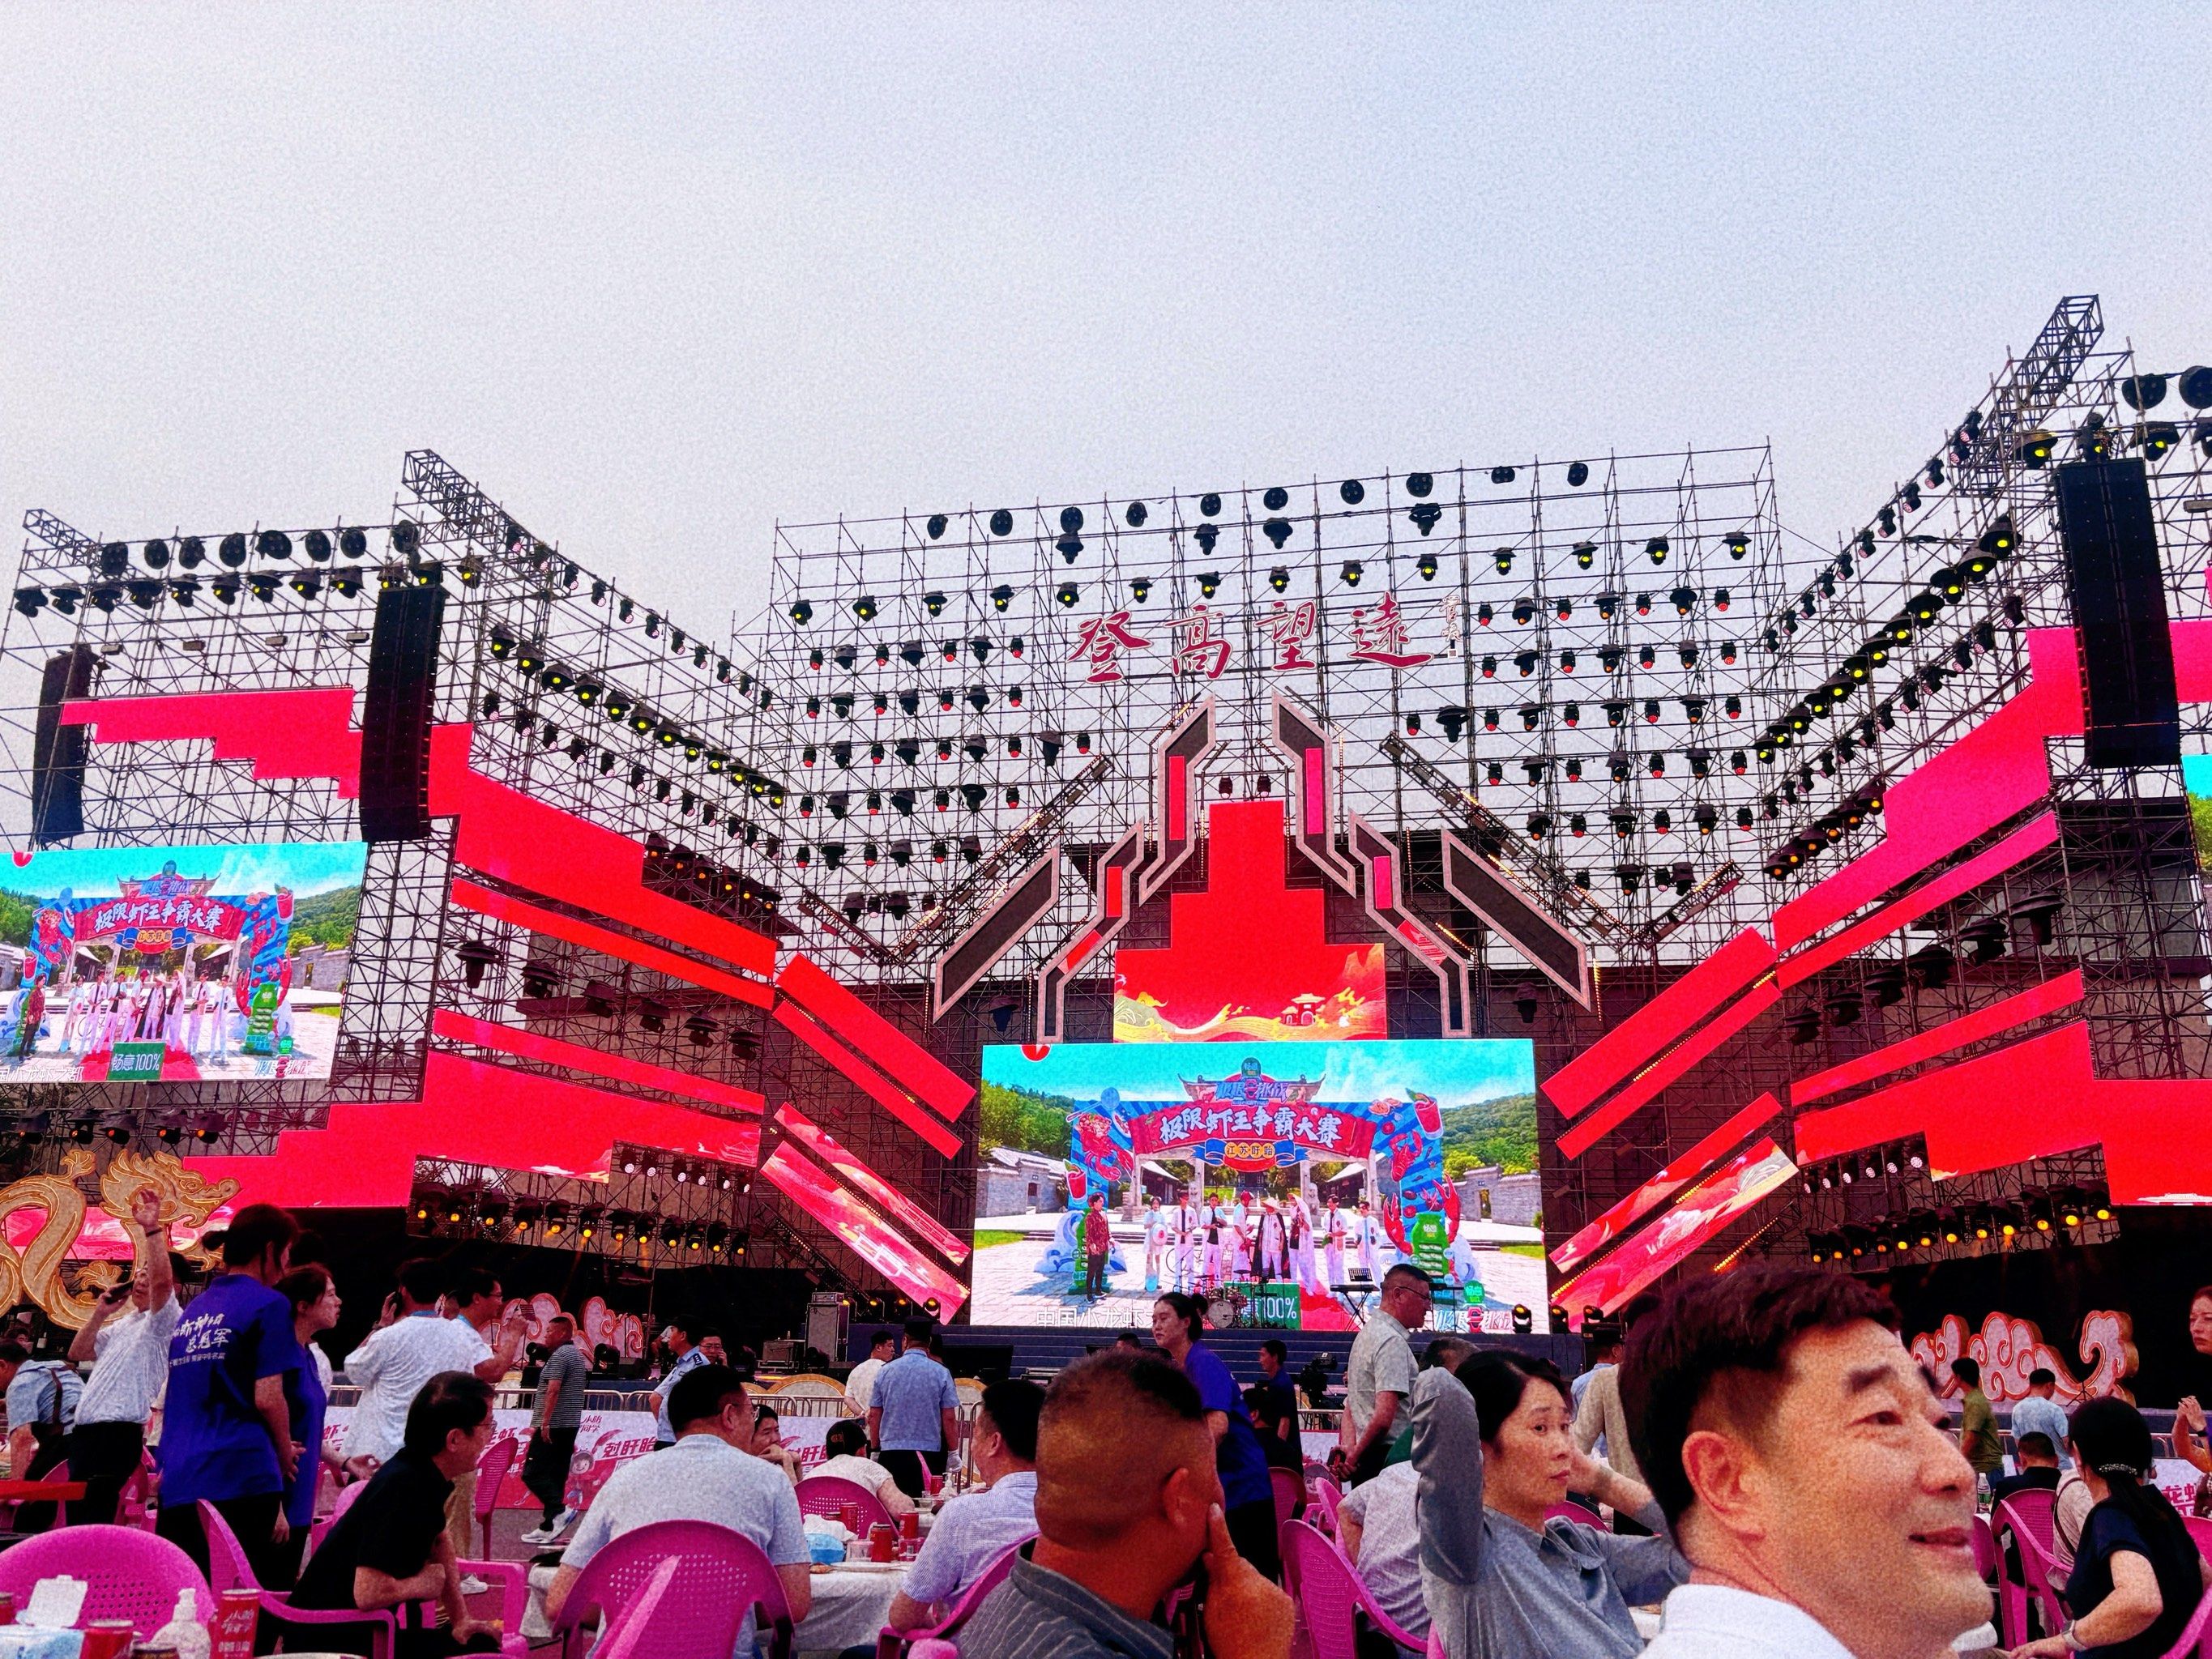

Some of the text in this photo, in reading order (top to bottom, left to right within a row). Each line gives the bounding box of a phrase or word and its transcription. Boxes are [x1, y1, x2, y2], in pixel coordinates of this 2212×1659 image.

[94, 899, 224, 933] 极限虾王争霸大赛
[1159, 1107, 1342, 1149] 极限虾王争霸大赛
